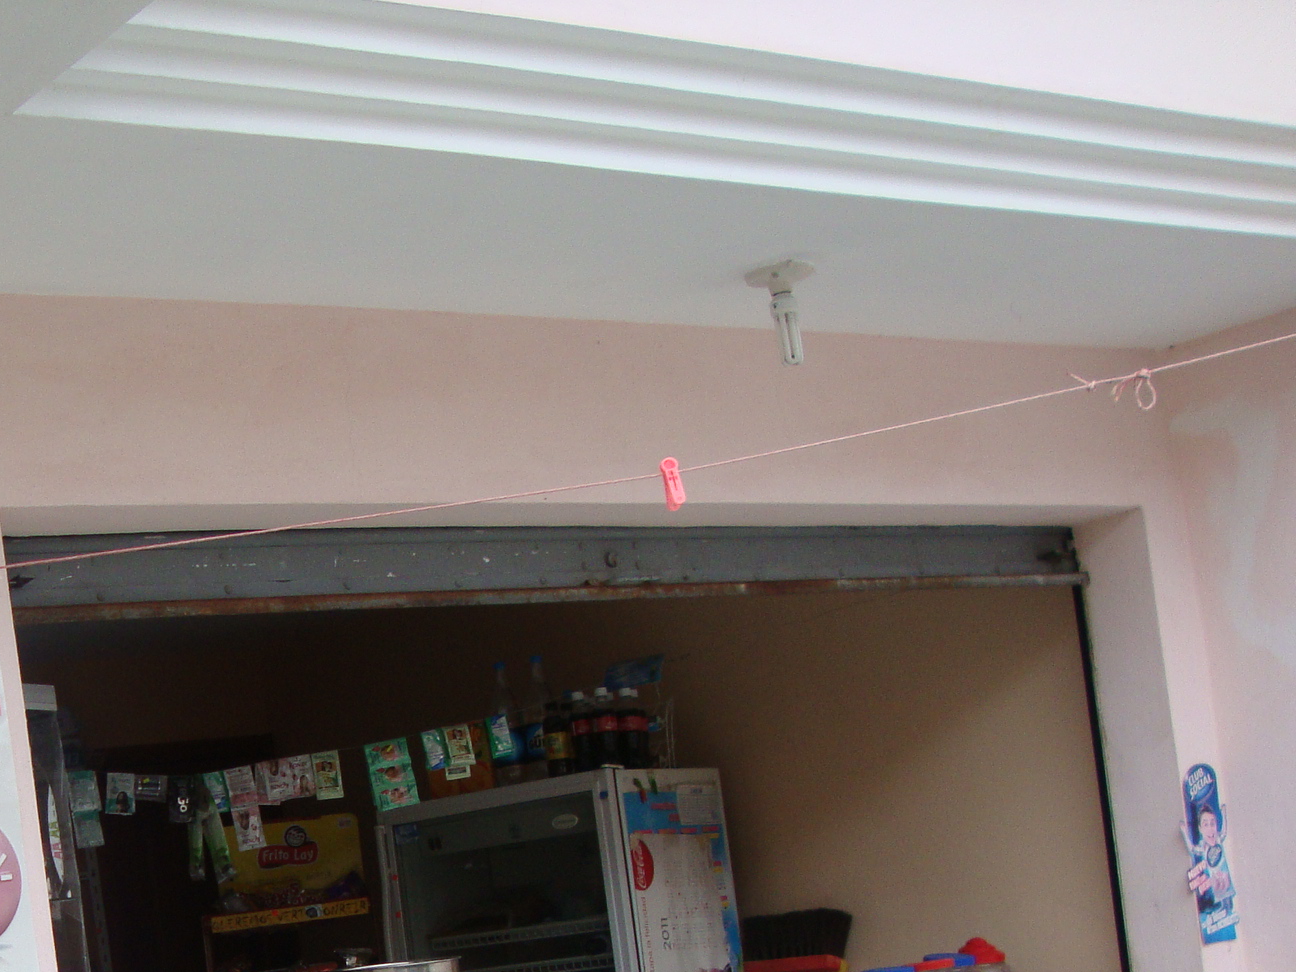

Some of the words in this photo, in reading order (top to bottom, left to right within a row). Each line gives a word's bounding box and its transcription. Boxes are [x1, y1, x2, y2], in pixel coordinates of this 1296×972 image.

[1188, 767, 1205, 786] CLUB
[1189, 773, 1214, 801] SOCIAL
[262, 850, 289, 863] Frito
[294, 848, 314, 861] Lay
[660, 917, 672, 950] 2011
